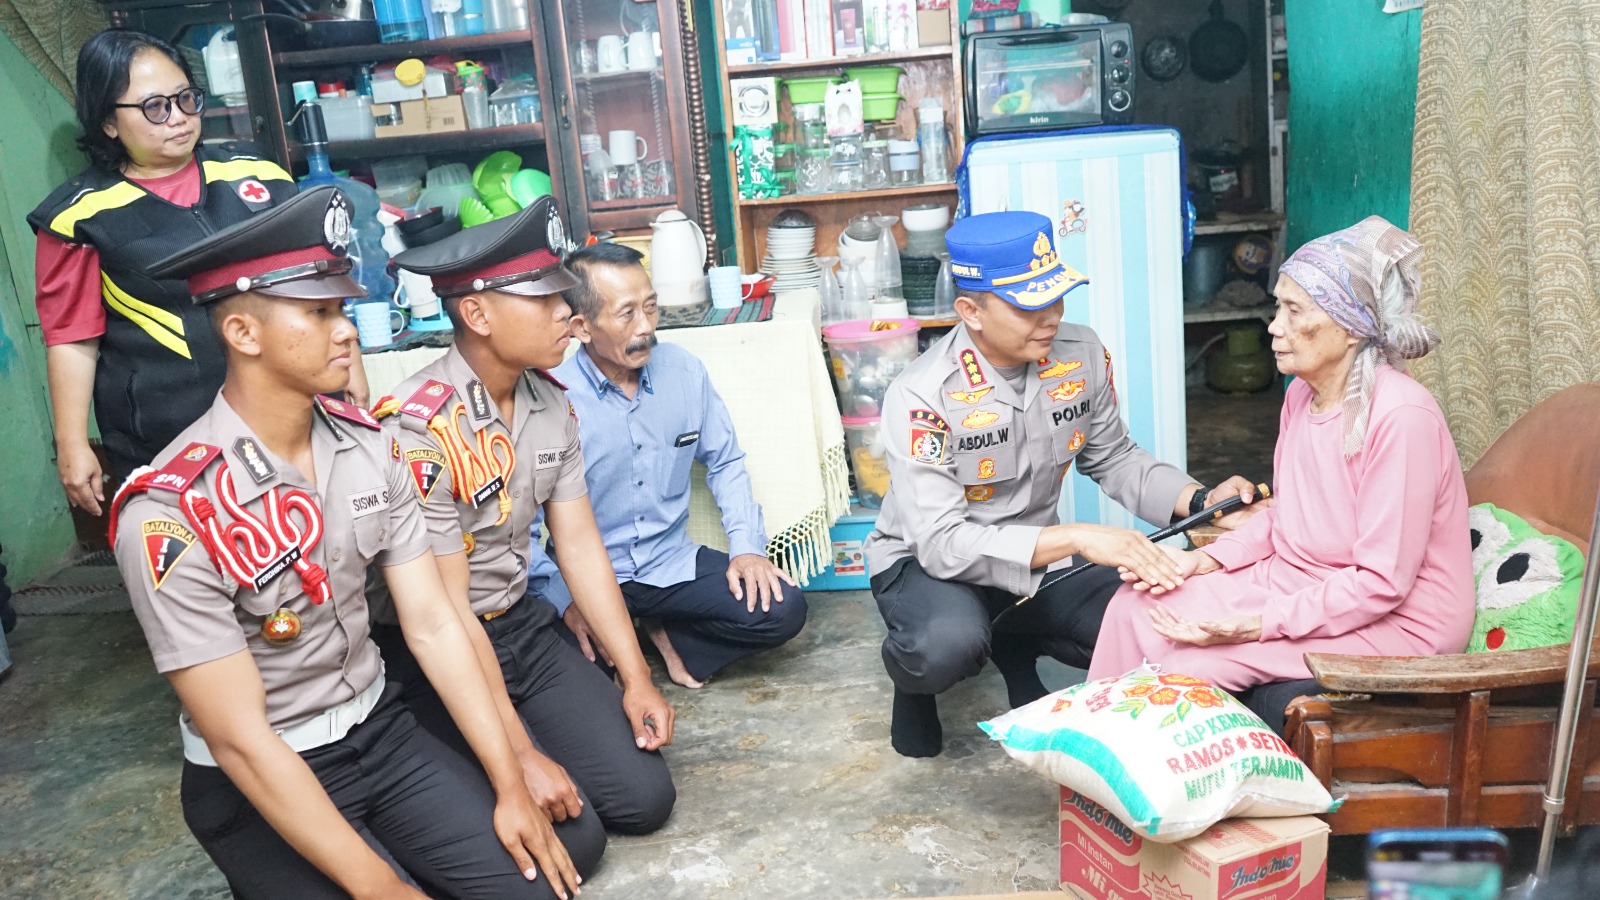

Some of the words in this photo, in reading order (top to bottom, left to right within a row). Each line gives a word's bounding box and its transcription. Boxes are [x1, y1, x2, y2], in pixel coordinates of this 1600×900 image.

[1030, 116, 1049, 124] kirin
[1026, 271, 1068, 292] PENG
[403, 402, 432, 417] SPN
[1052, 399, 1090, 426] POLRI
[915, 410, 946, 431] SPN
[957, 427, 1009, 452] ABDUL.W
[407, 450, 441, 461] BATALYON
[538, 452, 556, 465] SISWA
[420, 462, 434, 475] II
[152, 473, 187, 489] SPN
[352, 493, 380, 512] SISWA
[144, 521, 190, 539] BATALYON
[155, 554, 166, 572] 1
[1173, 724, 1206, 747] CAP
[1204, 712, 1271, 736] KEMBAN
[1166, 737, 1235, 775] RAMOS
[1184, 767, 1226, 801] MUTU
[1230, 755, 1304, 782] TERJAMIN
[1077, 832, 1087, 850] Mi
[1087, 842, 1114, 873] Instan
[1081, 865, 1107, 893] Mi
